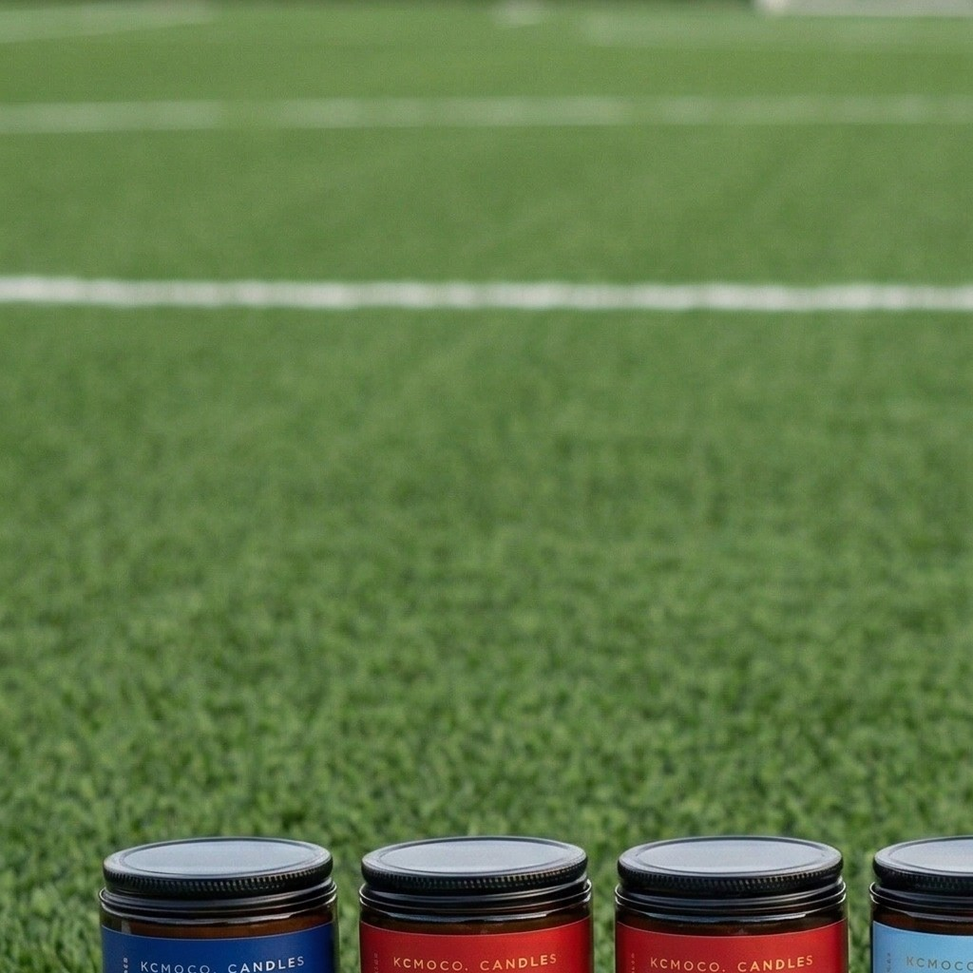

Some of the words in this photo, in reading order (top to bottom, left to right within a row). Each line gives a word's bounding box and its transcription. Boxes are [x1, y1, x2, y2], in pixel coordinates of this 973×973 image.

[228, 956, 305, 973] CANDLES
[394, 957, 468, 971] KCMOCO.
[480, 954, 557, 971] CANDLES
[651, 957, 725, 972] KCMOCO.
[737, 955, 813, 972] CANDLES
